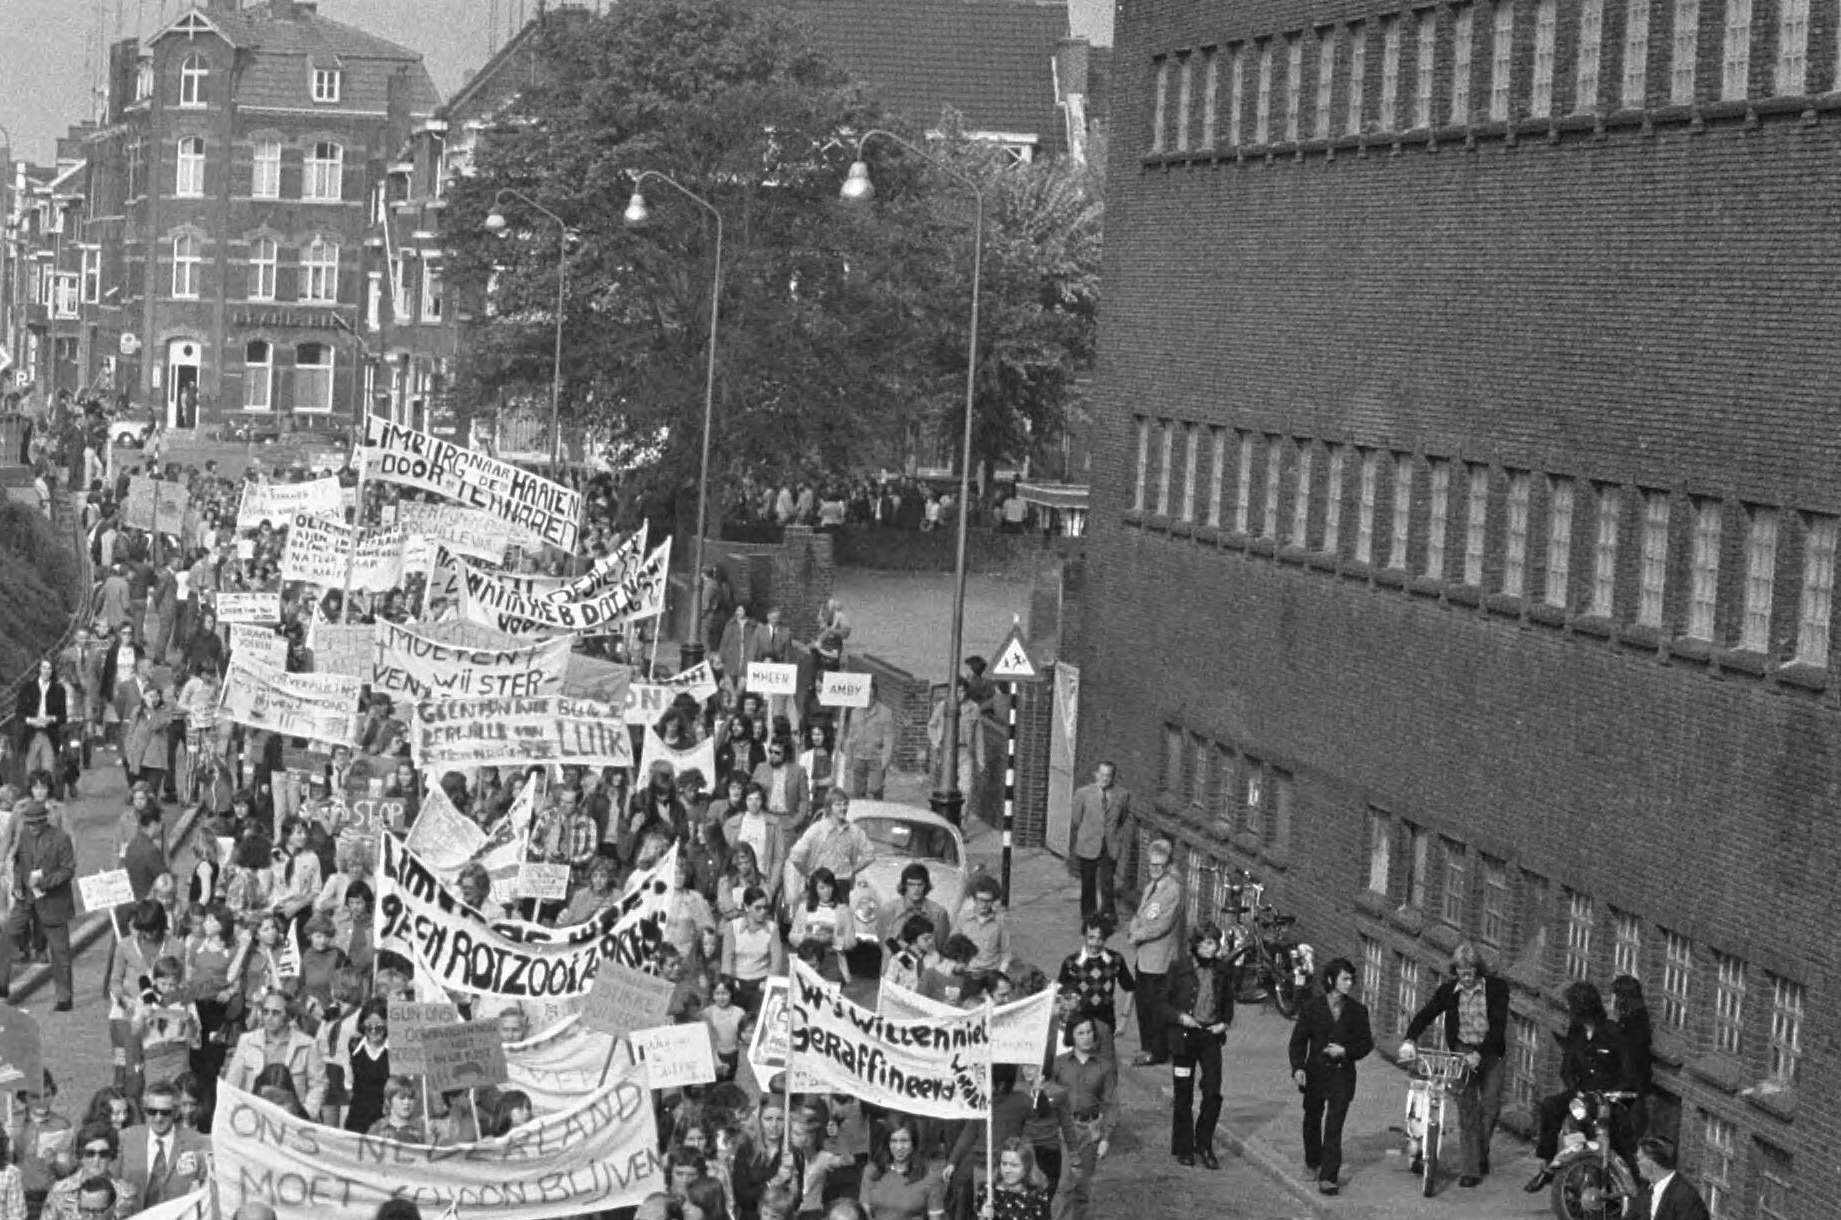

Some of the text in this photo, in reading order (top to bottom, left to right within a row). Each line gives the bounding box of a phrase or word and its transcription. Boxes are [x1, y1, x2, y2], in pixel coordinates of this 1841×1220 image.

[364, 416, 581, 520] LIMBURG NAAR DE HAAIEN
[381, 453, 445, 486] DOOR
[828, 683, 862, 697] AMBY
[353, 800, 404, 827] STOP
[229, 1102, 319, 1157] ONS
[239, 1166, 365, 1206] MOET
